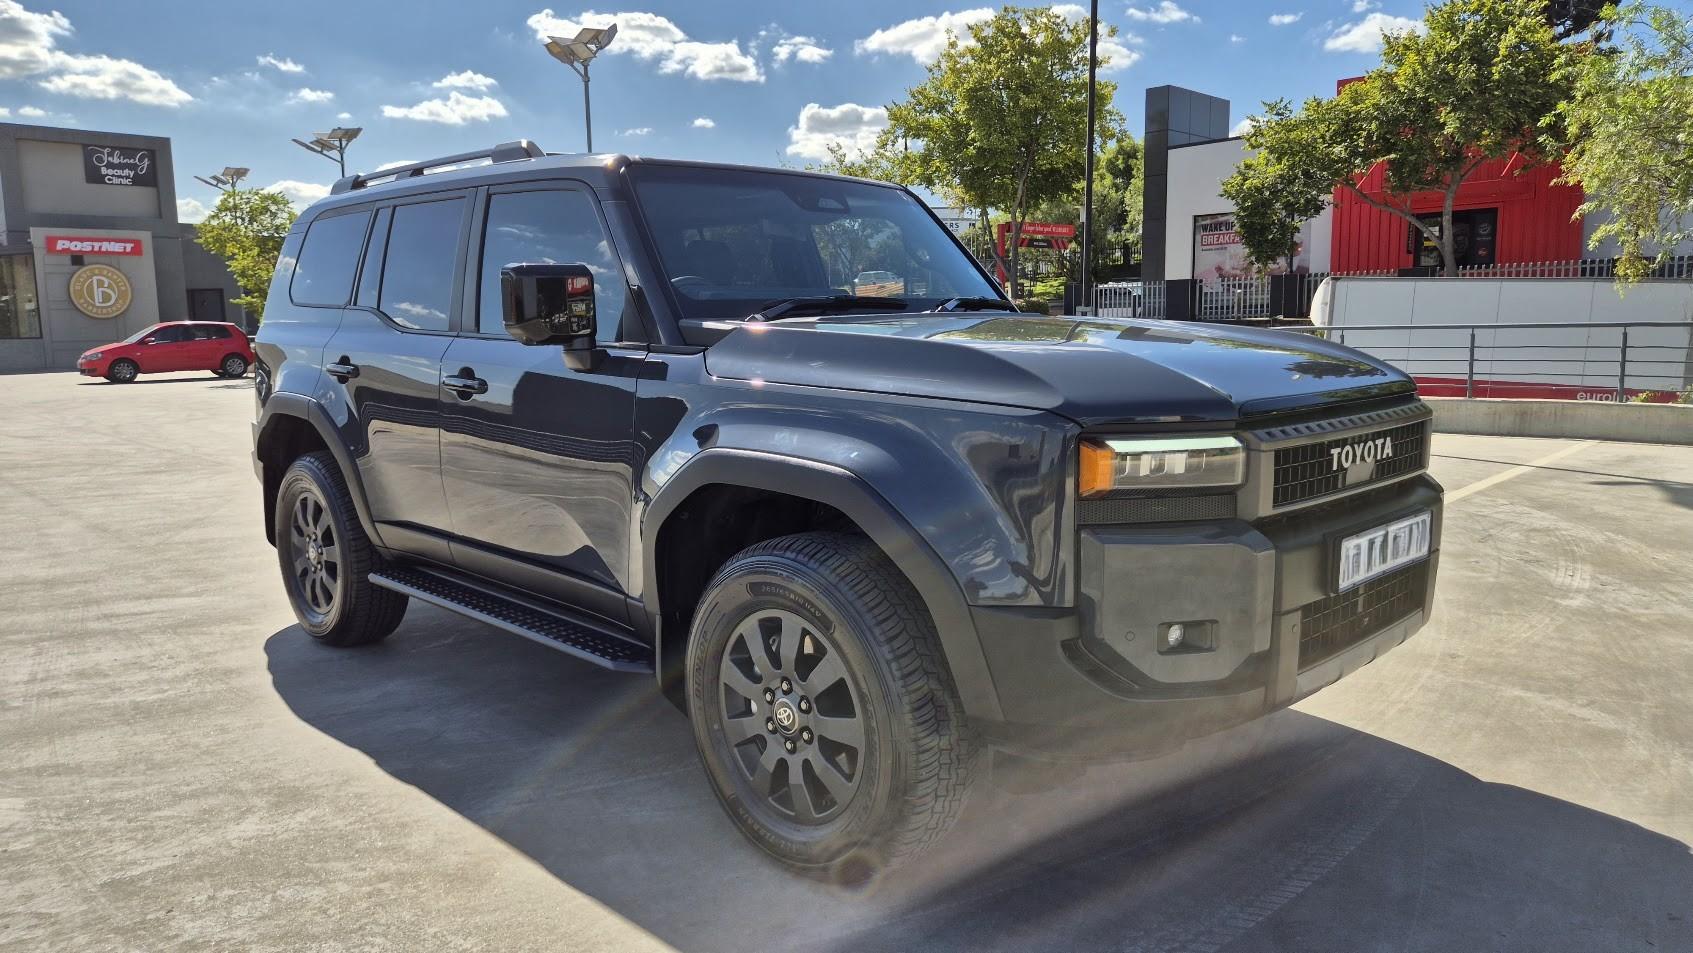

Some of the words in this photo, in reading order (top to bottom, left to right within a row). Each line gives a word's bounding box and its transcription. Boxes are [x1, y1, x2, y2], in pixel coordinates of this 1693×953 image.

[101, 167, 134, 177] Beauty
[105, 176, 132, 184] Clinic
[1201, 222, 1223, 232] WAKE
[1331, 437, 1392, 470] TOYOTA
